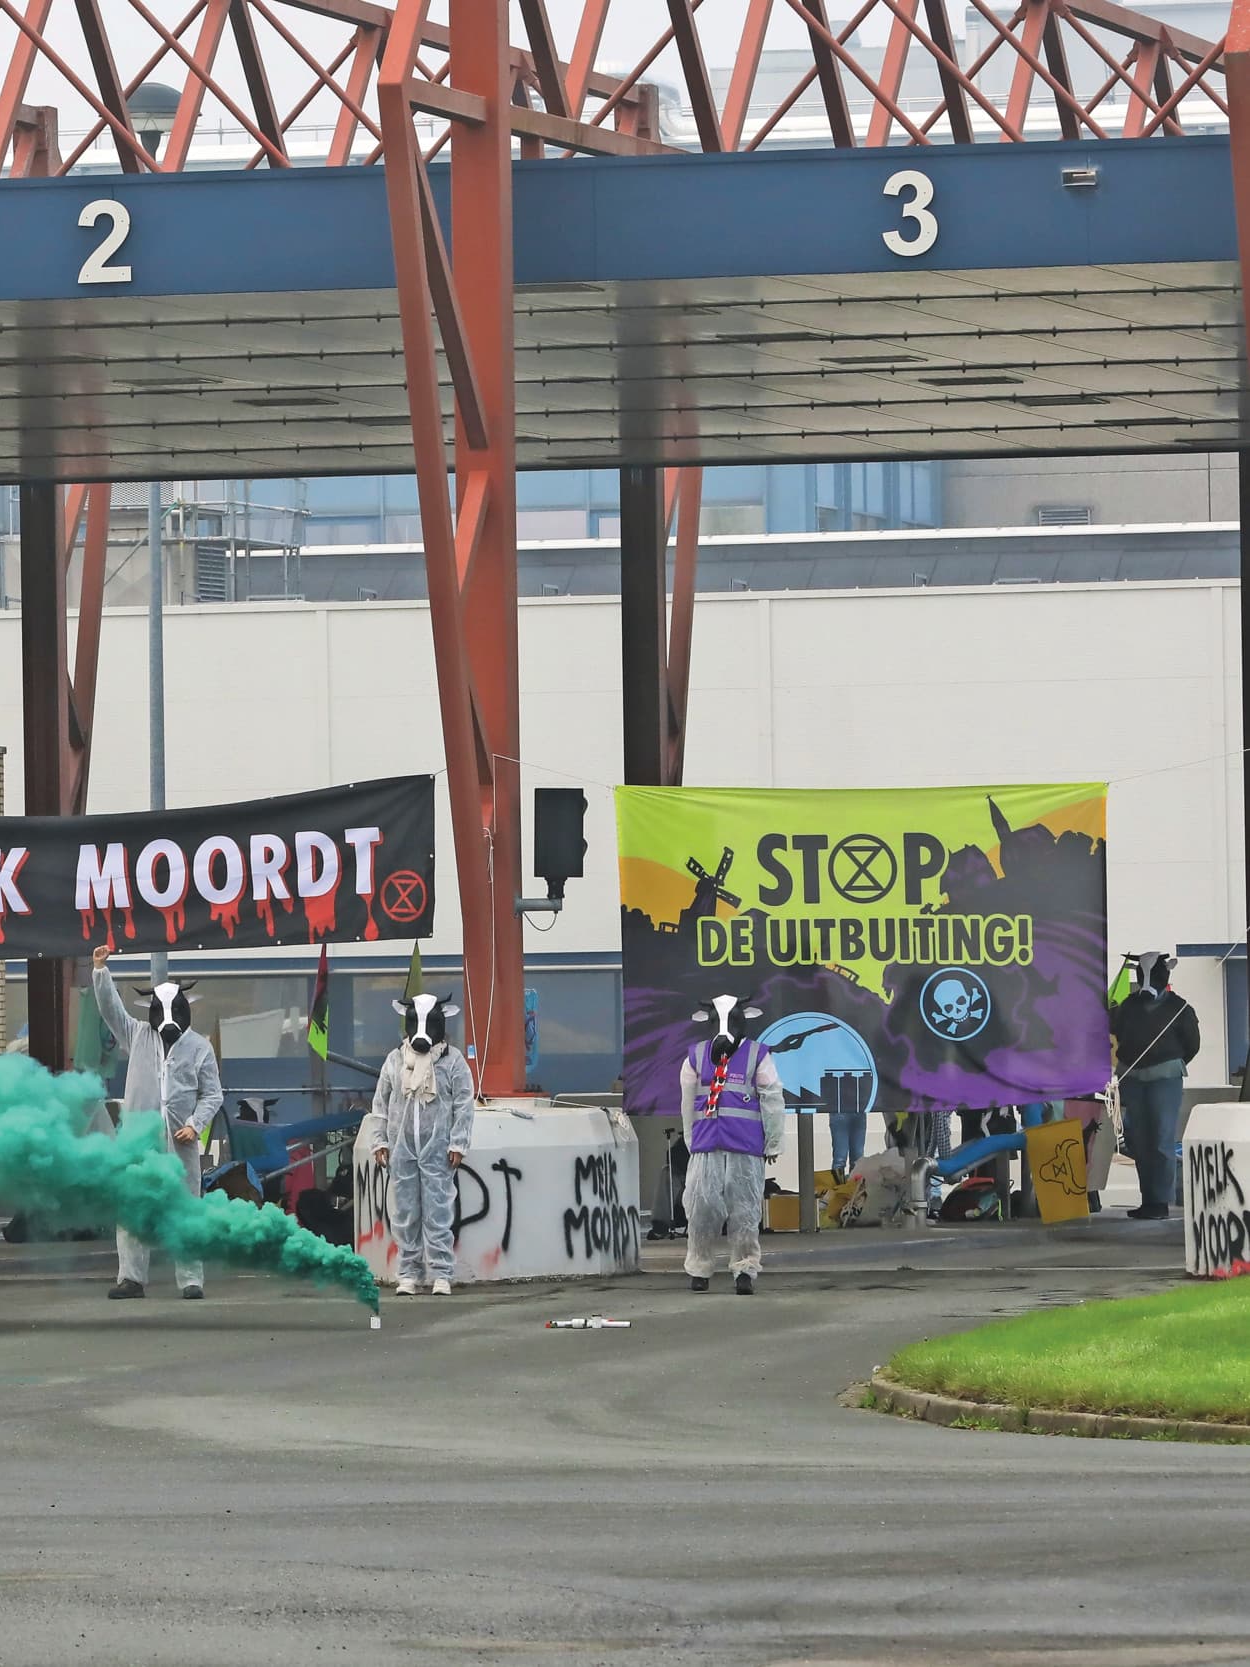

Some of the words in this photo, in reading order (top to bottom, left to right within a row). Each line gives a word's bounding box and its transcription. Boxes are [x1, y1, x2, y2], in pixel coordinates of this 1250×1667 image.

[77, 199, 132, 284] 2
[882, 169, 938, 257] 3
[75, 826, 382, 911] MOORDT
[757, 832, 946, 906] STOP
[701, 918, 752, 963] DE
[768, 917, 1031, 963] UITBUITING!
[1190, 1141, 1244, 1218] MELK
